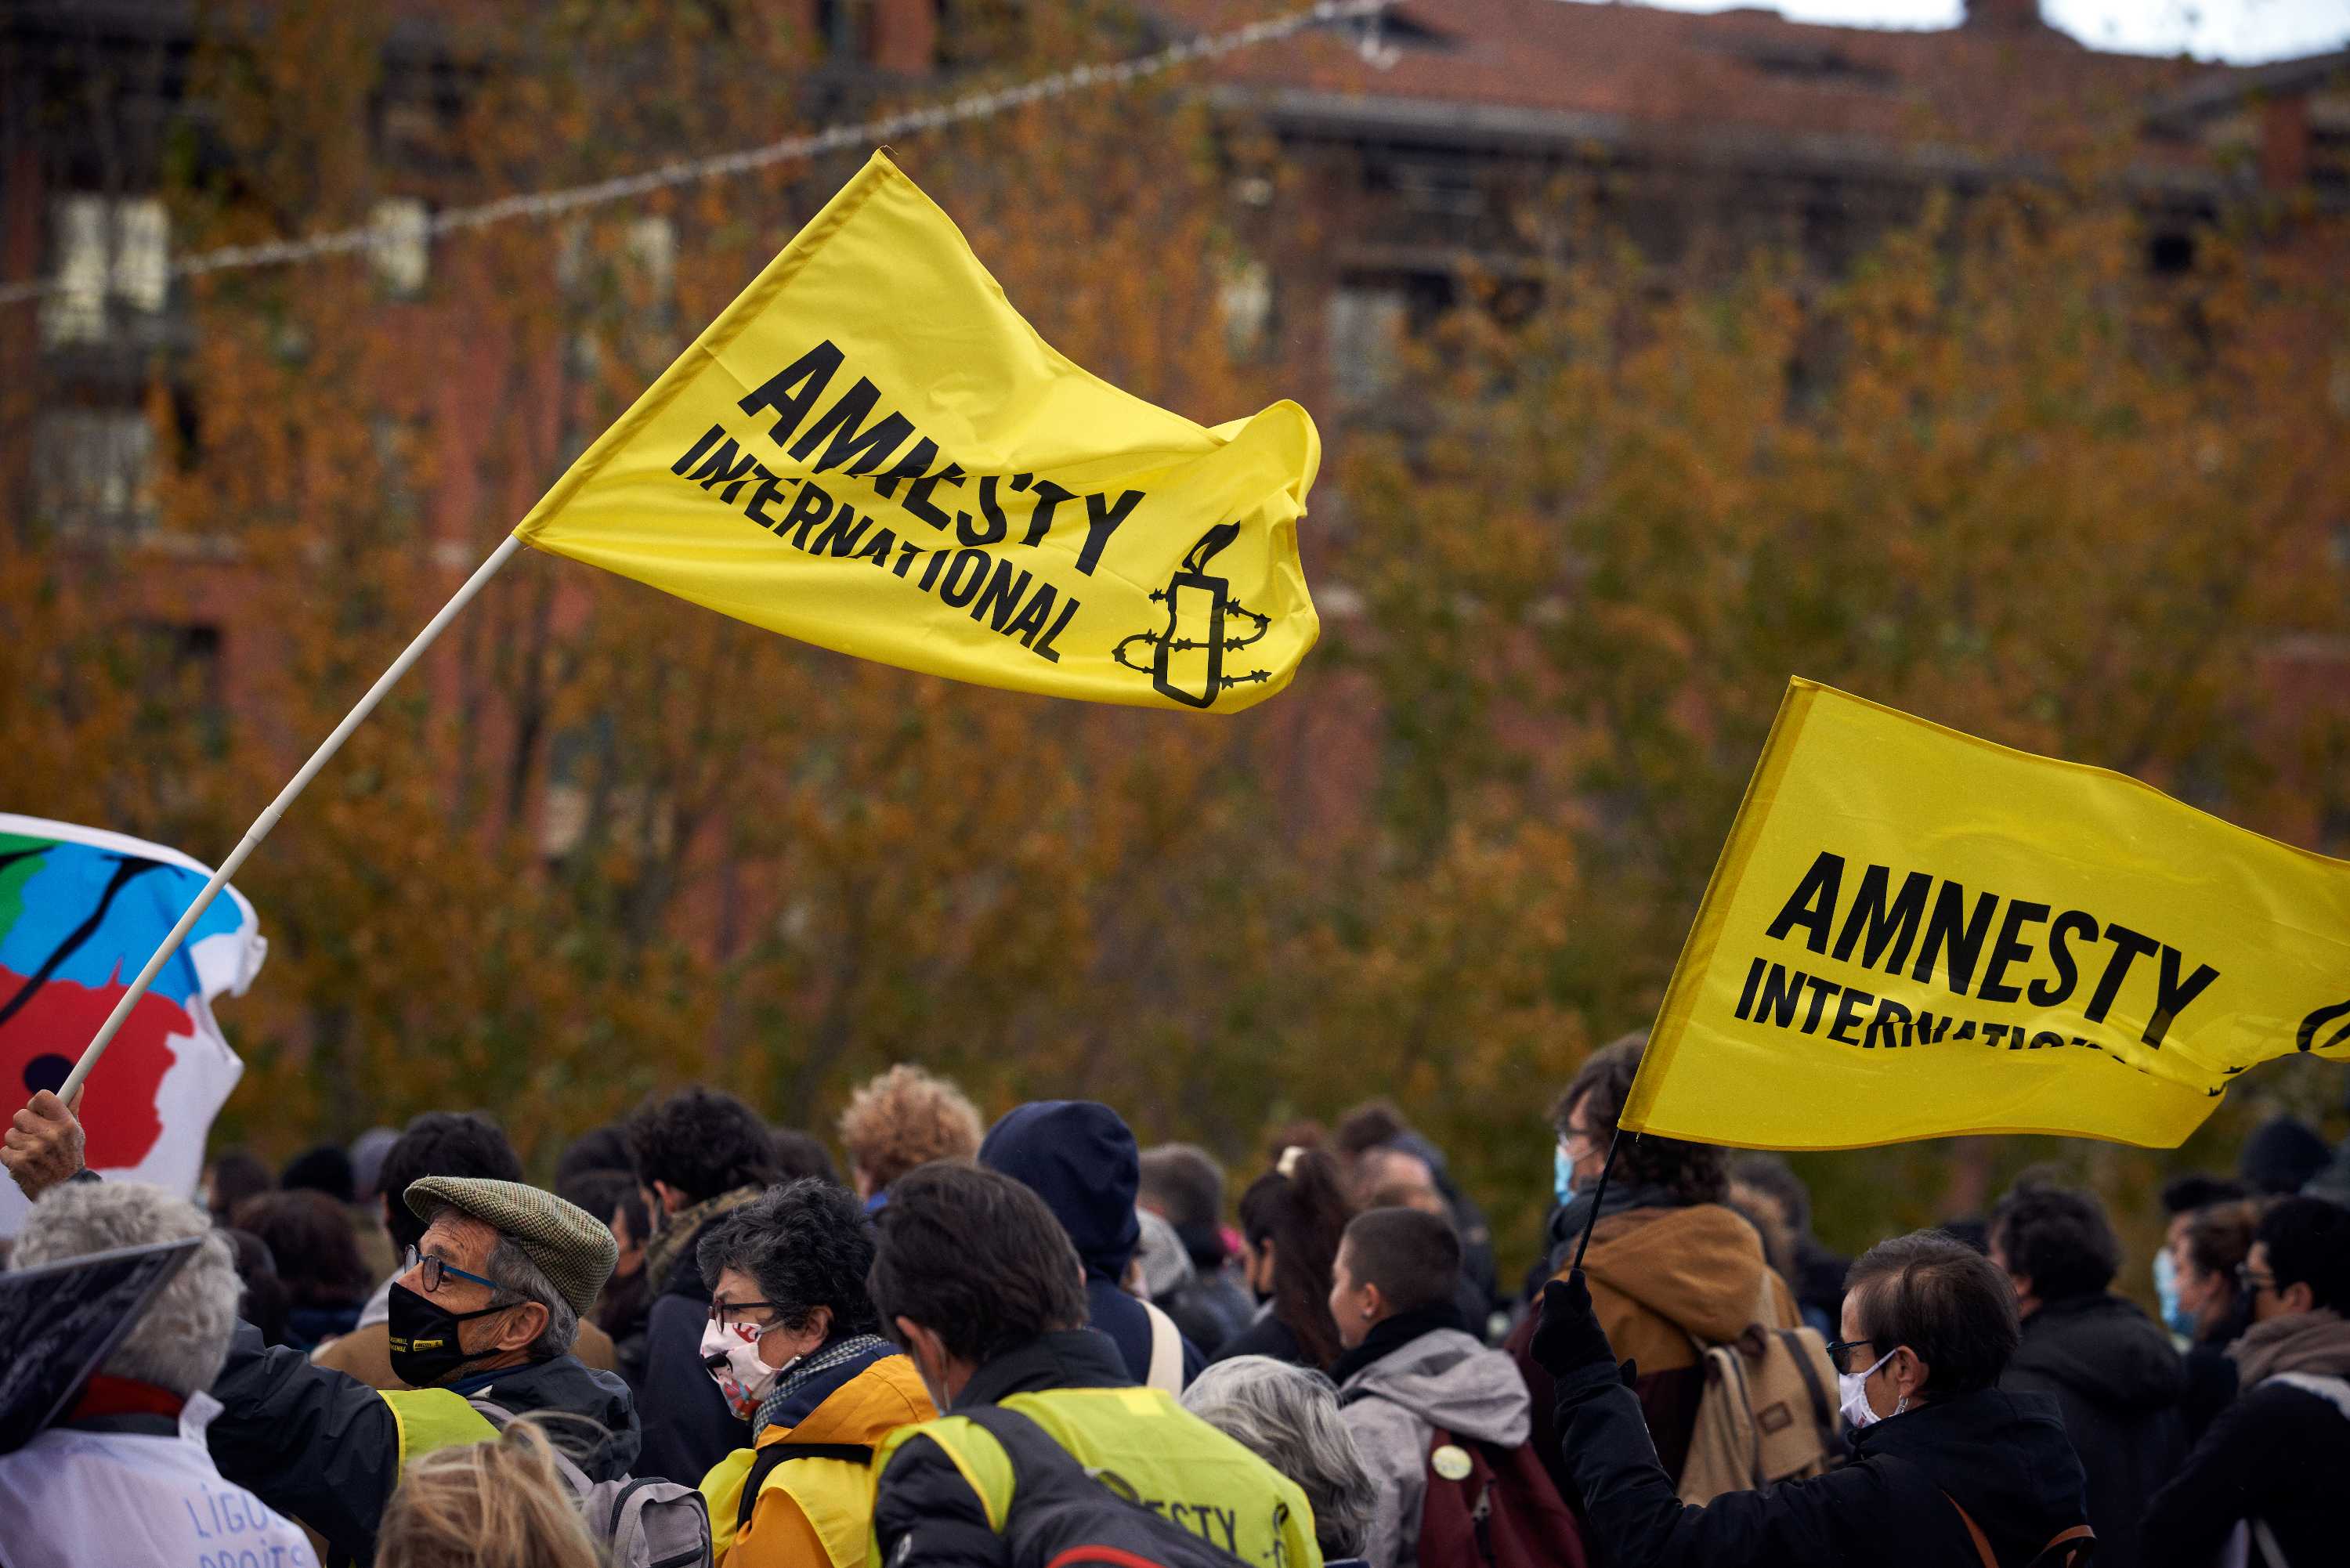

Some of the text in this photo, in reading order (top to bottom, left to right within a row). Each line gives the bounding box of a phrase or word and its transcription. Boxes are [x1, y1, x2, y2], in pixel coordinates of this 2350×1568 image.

[670, 423, 1081, 664] INTERNATIONAL
[738, 339, 1146, 576] AMNESTY
[1765, 851, 2221, 1050] AMNESTY
[183, 1483, 284, 1538] LIGU
